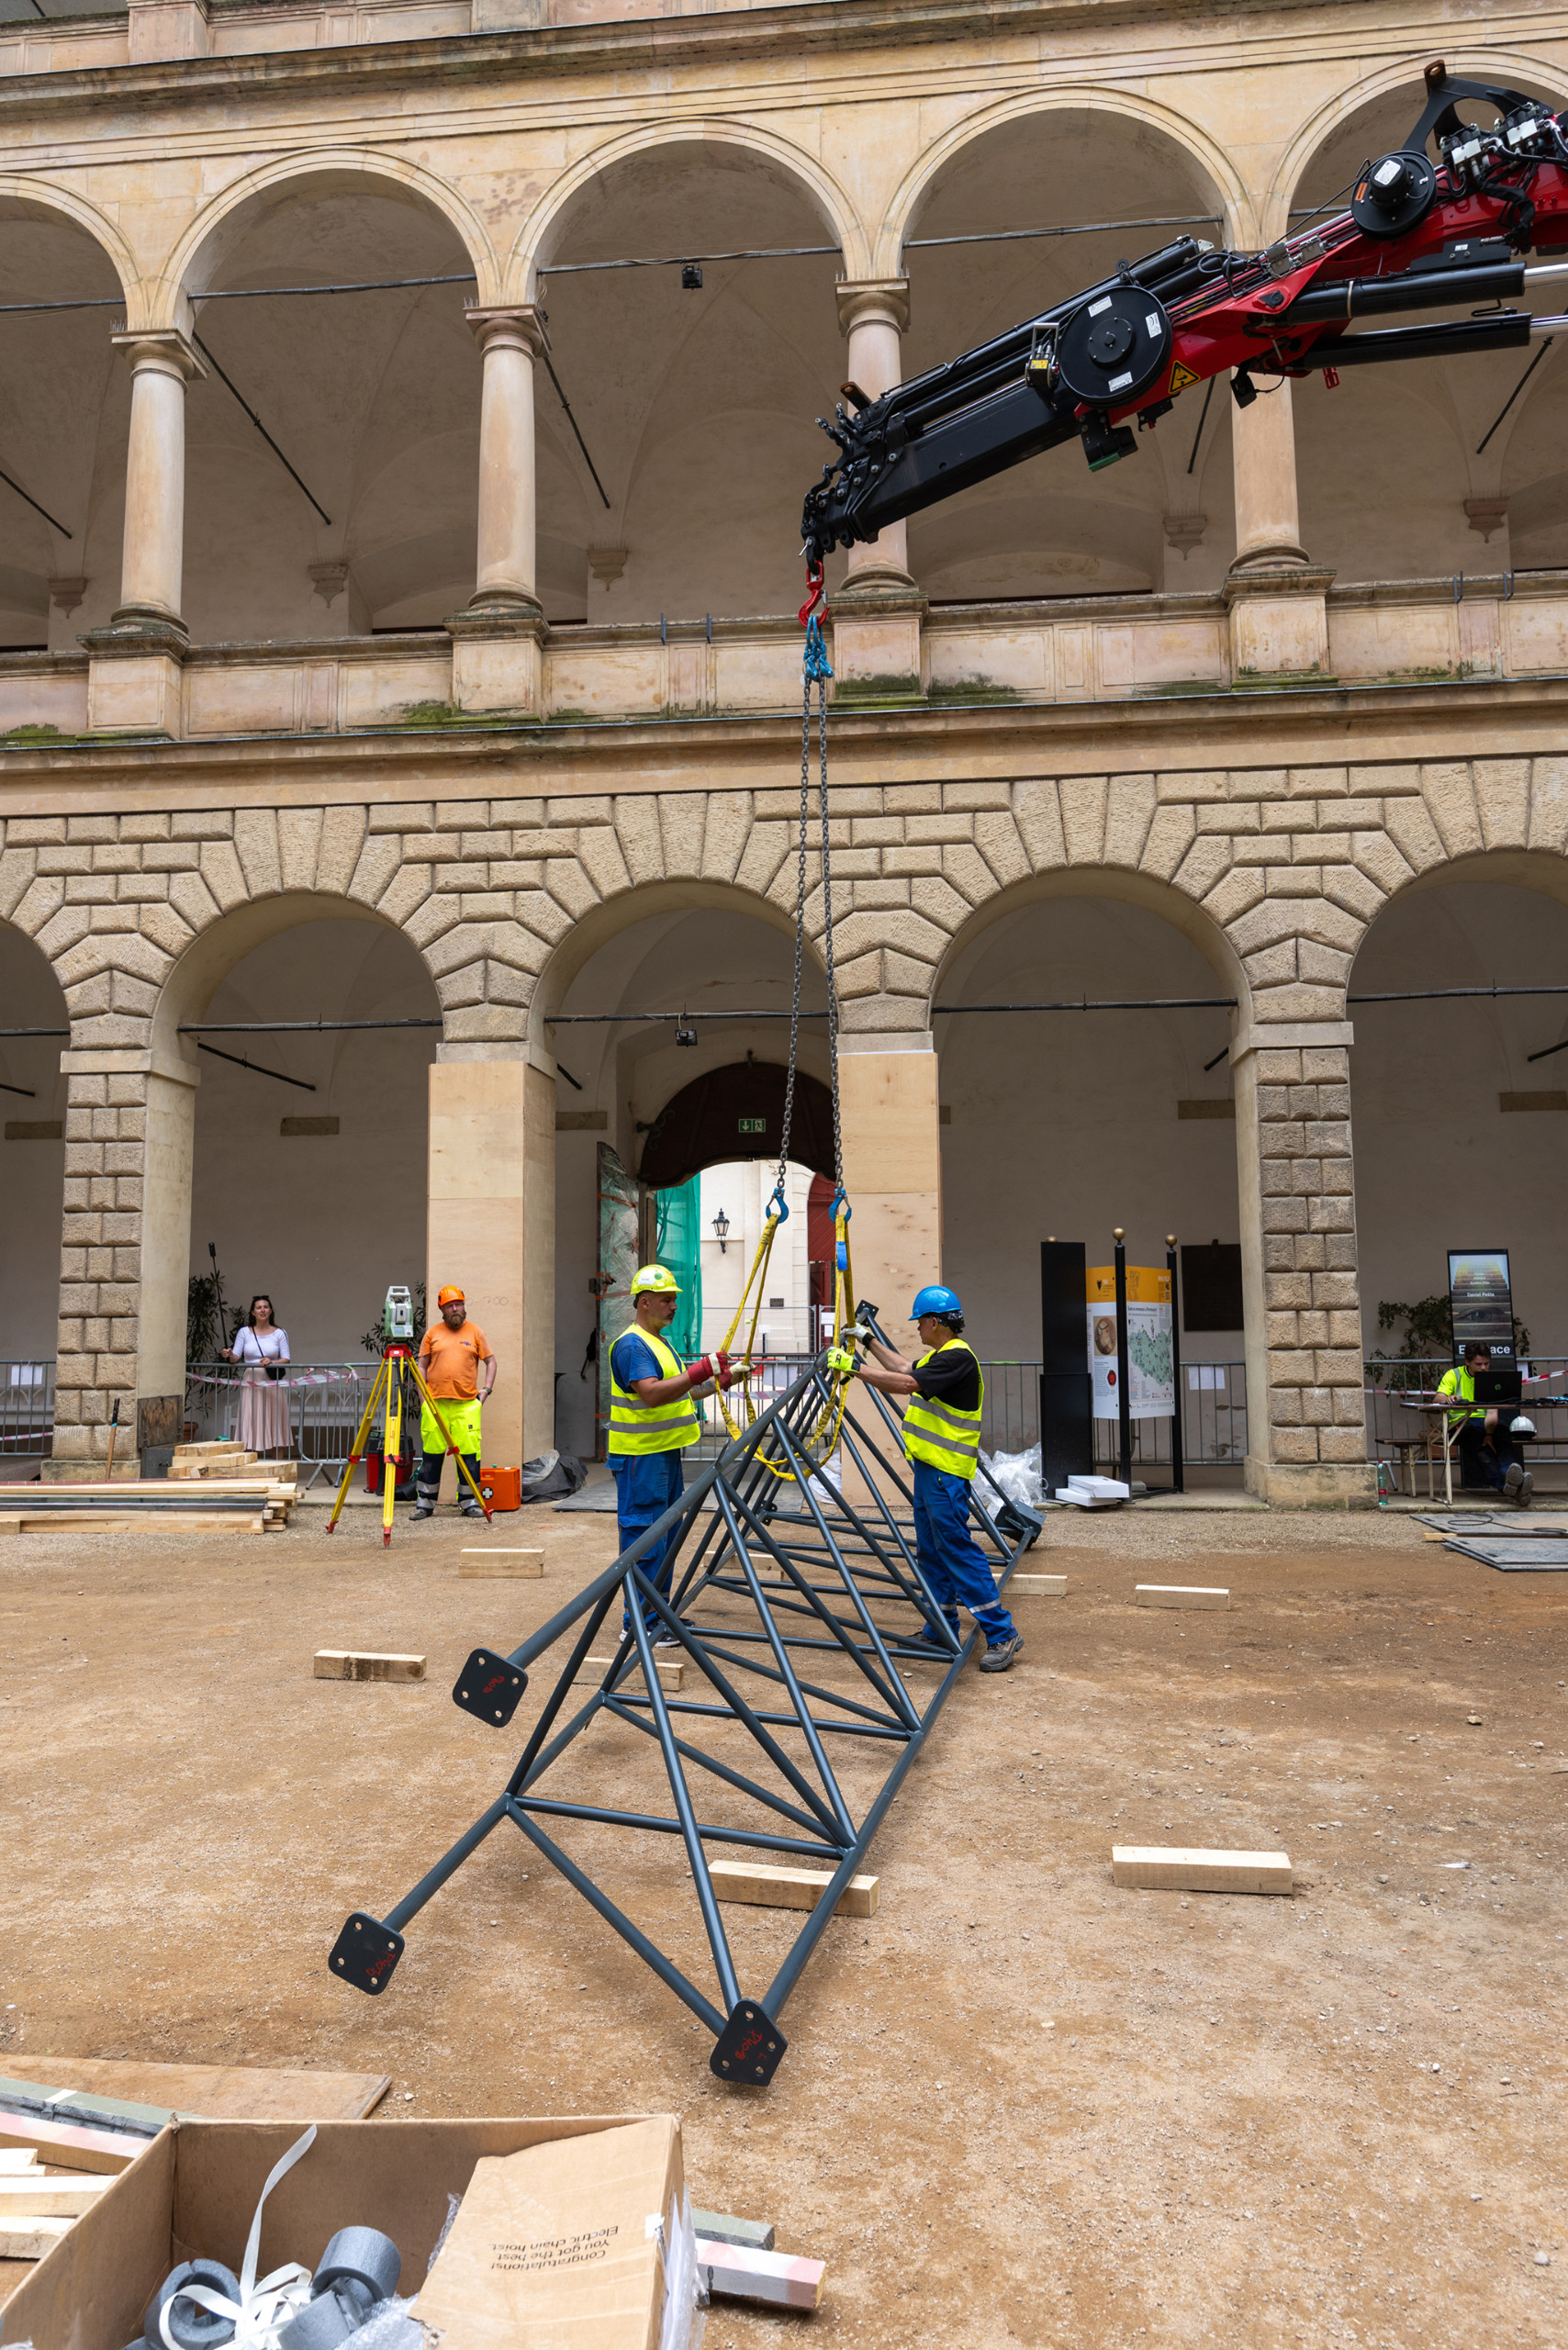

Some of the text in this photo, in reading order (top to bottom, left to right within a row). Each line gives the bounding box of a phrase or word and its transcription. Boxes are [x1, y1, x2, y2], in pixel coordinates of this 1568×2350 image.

[530, 2239, 566, 2250] chain
[570, 2225, 619, 2244] Electric
[491, 2249, 606, 2271] Congratulations!
[498, 2239, 610, 2262] You got the best
